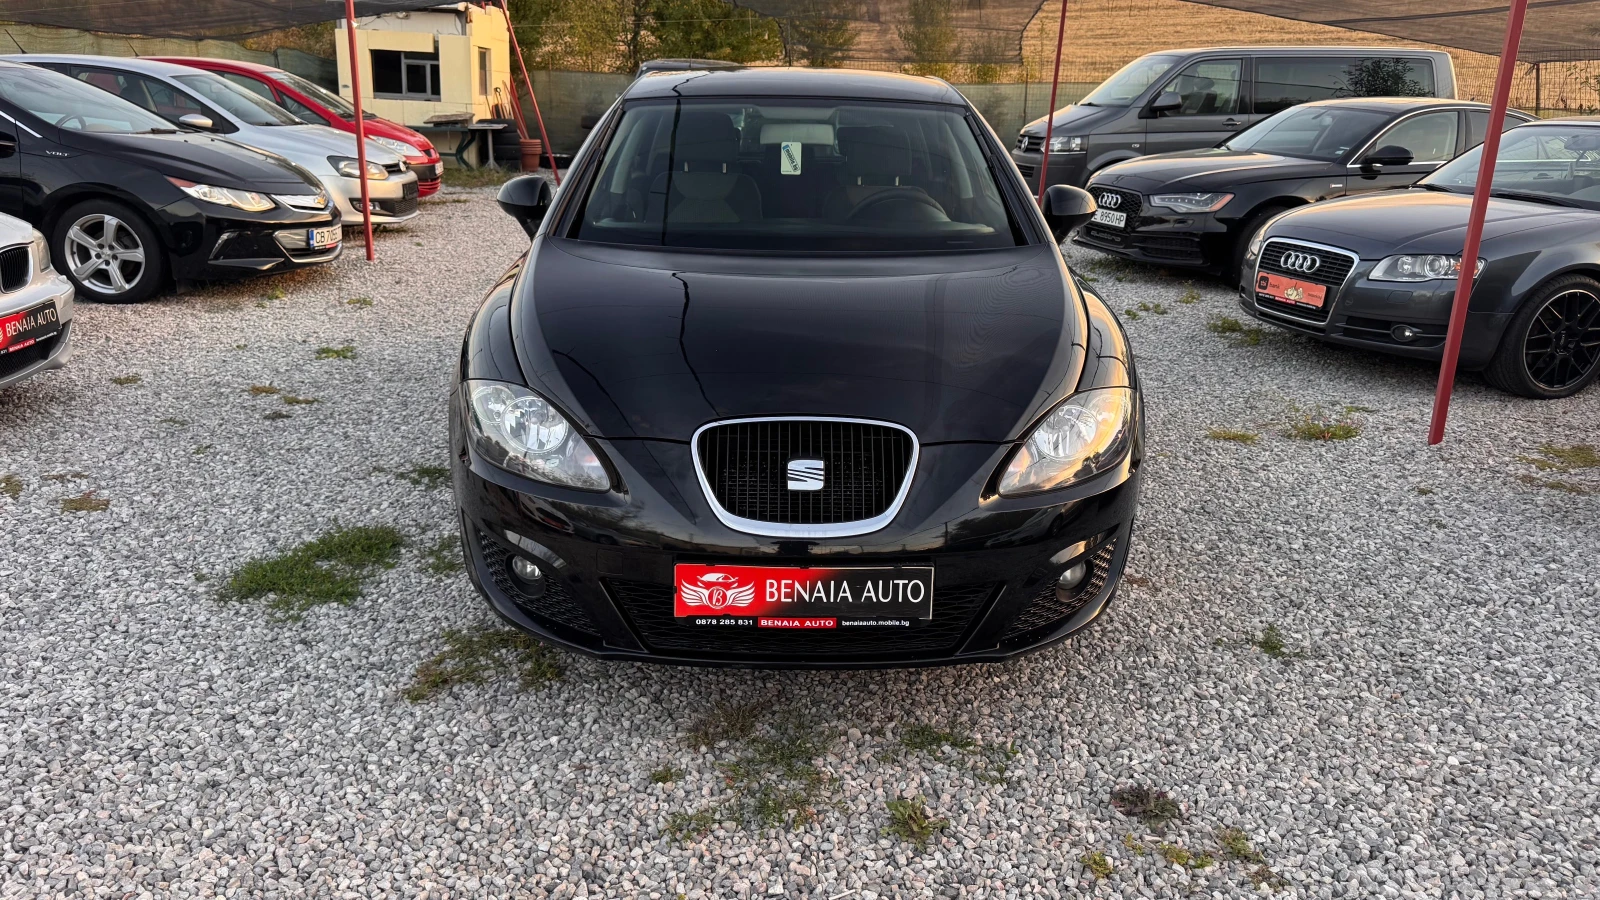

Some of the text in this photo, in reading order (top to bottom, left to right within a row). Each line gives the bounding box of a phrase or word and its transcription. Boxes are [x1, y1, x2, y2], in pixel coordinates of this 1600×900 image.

[1100, 211, 1115, 223] 8950
[315, 231, 325, 244] CB
[5, 314, 36, 337] BENAIA
[37, 308, 57, 327] AUTO
[766, 579, 925, 603] BENAIA AUTO
[695, 618, 718, 626] 0878
[719, 618, 736, 626] 285
[760, 619, 800, 627] BENAIA
[804, 619, 834, 627] AUTO
[842, 619, 910, 627] benaiaauto.mobile.bg
